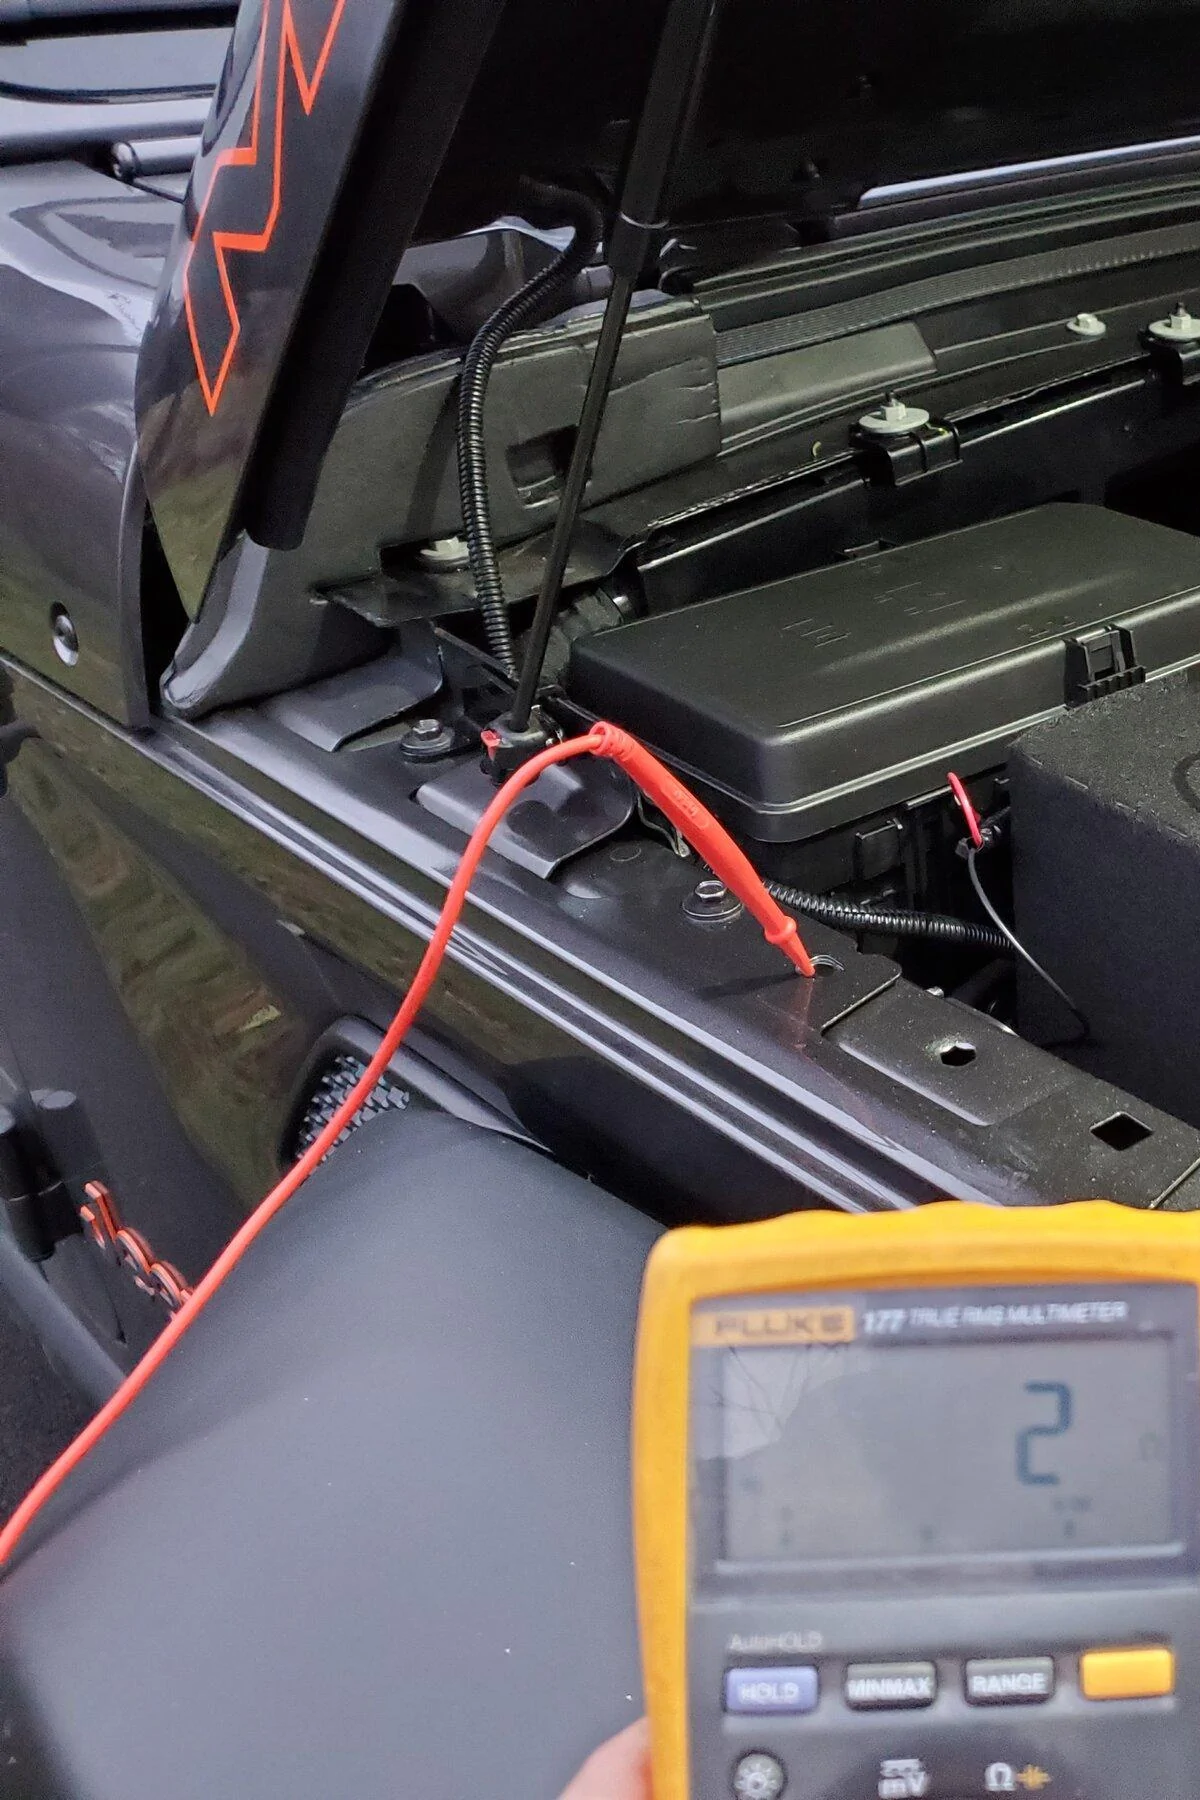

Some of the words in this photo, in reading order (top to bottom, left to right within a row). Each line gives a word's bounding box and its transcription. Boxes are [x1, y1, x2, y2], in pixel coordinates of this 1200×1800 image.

[863, 1308, 905, 1334] 177
[1007, 1301, 1128, 1324] MULTIMETER
[1015, 1380, 1072, 1486] 2
[738, 1682, 800, 1703] HOLD
[971, 1673, 1046, 1696] RANGE
